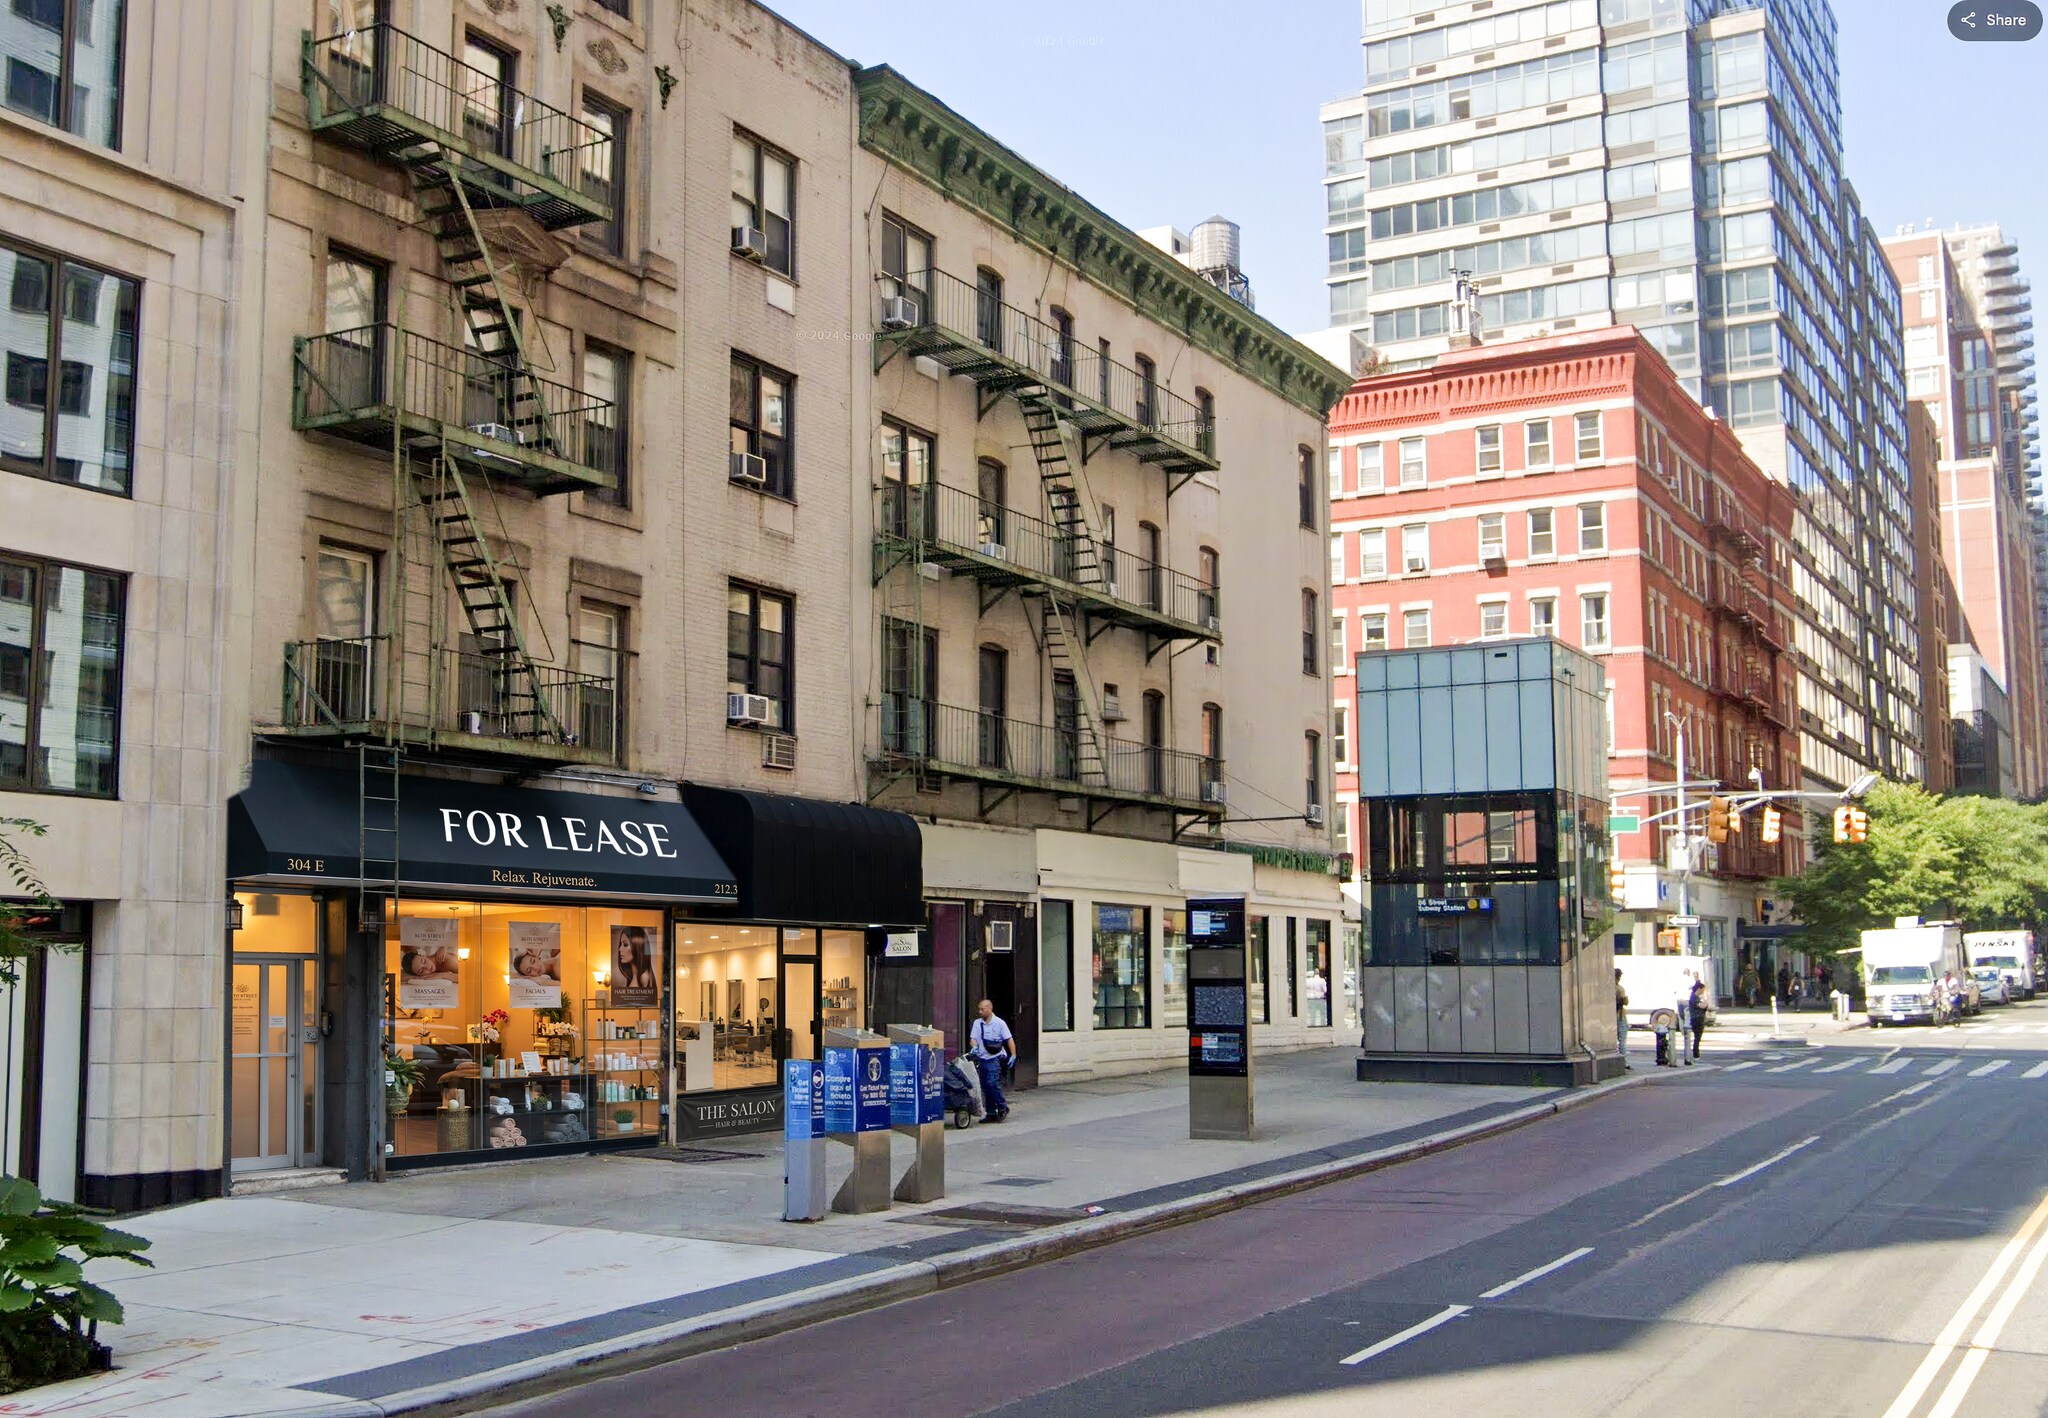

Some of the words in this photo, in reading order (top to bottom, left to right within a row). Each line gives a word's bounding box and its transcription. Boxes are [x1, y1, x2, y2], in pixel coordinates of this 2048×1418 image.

[440, 808, 529, 848] FOR
[536, 814, 678, 859] LEASE
[287, 858, 311, 871] 304
[315, 860, 325, 872] E
[492, 869, 529, 884] Relax.
[532, 872, 597, 888] Rejuvenate.
[714, 883, 738, 895] 212.3
[697, 1104, 727, 1121] THE
[730, 1099, 776, 1117] SALON
[715, 1119, 731, 1128] HAIR
[731, 1119, 736, 1127] &
[738, 1117, 760, 1126] BEAUTY
